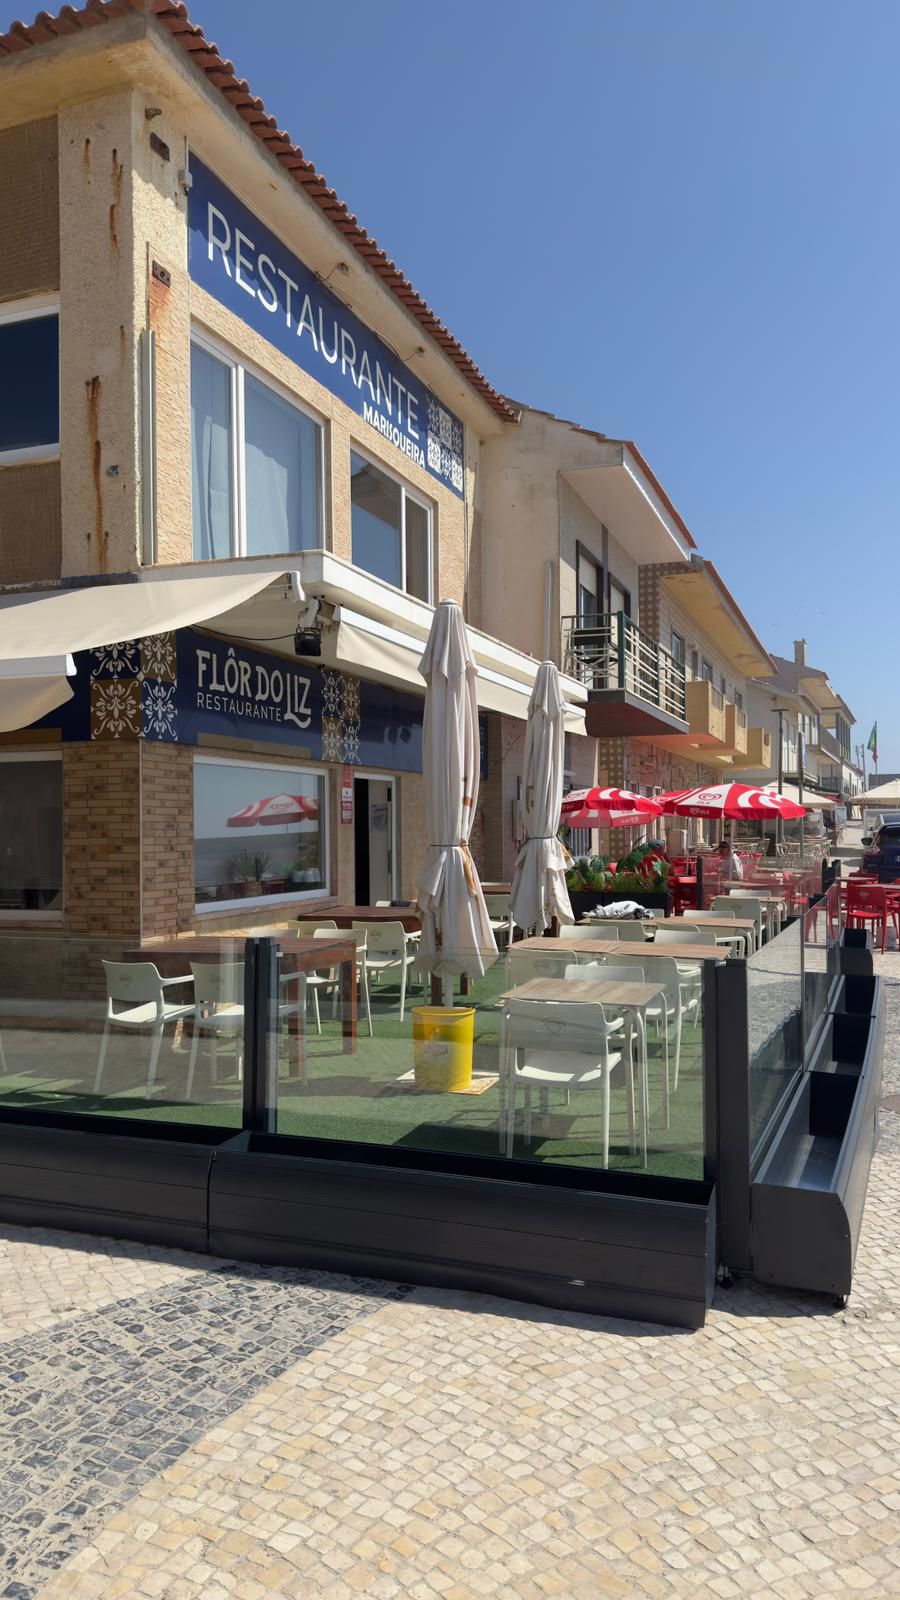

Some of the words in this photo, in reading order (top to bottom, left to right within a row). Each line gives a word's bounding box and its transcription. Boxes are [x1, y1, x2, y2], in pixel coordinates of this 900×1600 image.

[207, 200, 420, 441] RESTAURANTE
[362, 402, 426, 469] MARISQUEIRA
[195, 647, 252, 698] FLÔR
[255, 665, 284, 703] DO
[283, 672, 312, 729] LIZ
[196, 692, 282, 722] RESTAURANTE
